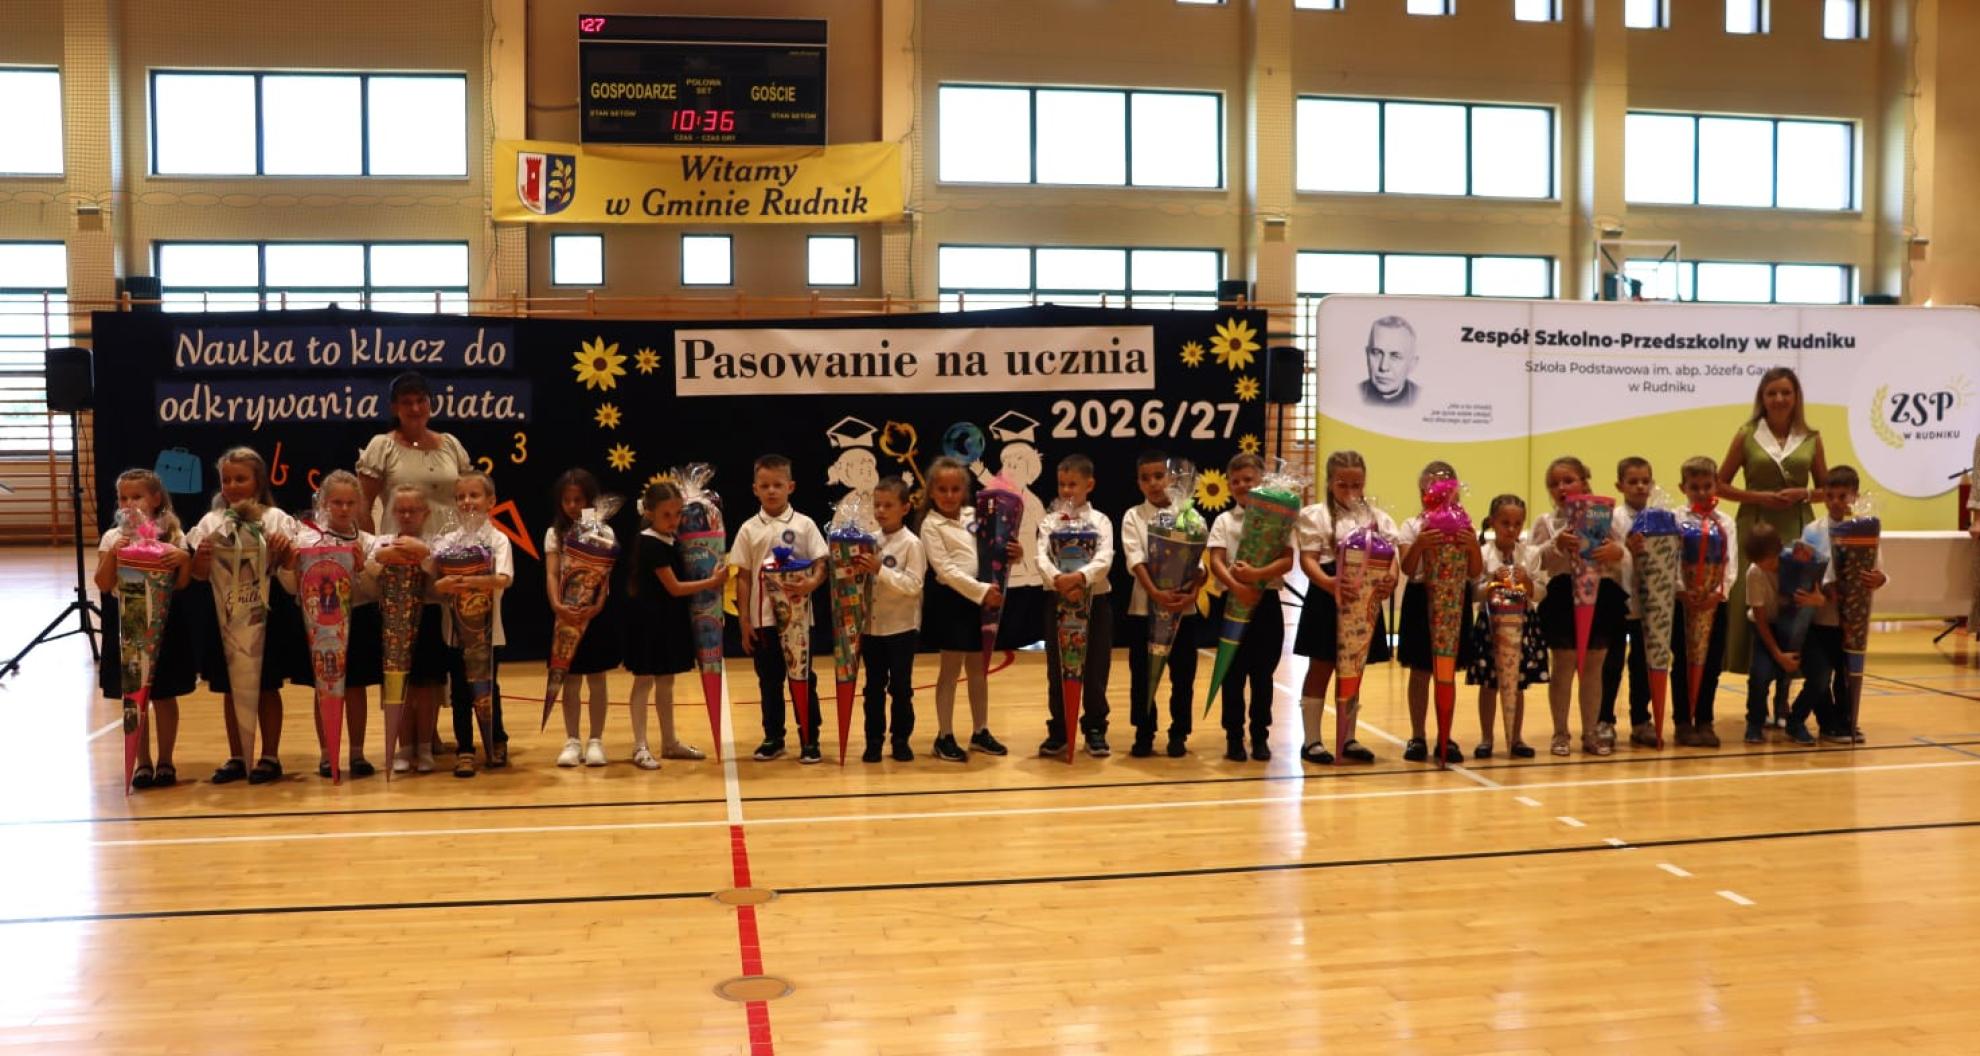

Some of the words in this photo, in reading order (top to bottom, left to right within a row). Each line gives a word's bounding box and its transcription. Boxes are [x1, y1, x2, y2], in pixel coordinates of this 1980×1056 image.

[591, 82, 677, 99] GOSPODARZE
[751, 82, 796, 102] GOŚCIE
[671, 110, 735, 132] 10:36
[681, 155, 798, 186] Witamy
[605, 198, 630, 216] w
[643, 188, 750, 217] Gminie
[760, 186, 868, 216] Rudnik
[175, 329, 296, 368] Nauka
[307, 336, 341, 366] to
[351, 328, 446, 365] klucz
[464, 328, 506, 366] do
[1461, 327, 1530, 348] Zespół
[1535, 329, 1750, 353] Szkolno-Przedszkolny
[1755, 336, 1772, 349] w
[1777, 332, 1856, 349] Rudniku
[681, 339, 918, 379] Pasowanie
[935, 351, 988, 377] na
[1004, 337, 1149, 376] ucznia
[1525, 361, 1566, 373] Szkoła
[1570, 362, 1650, 376] Podstawowa
[1653, 364, 1671, 376] im.
[1675, 364, 1702, 379] abp.
[1704, 364, 1743, 377] Józefa
[1628, 384, 1640, 392] w
[1644, 382, 1695, 393] Rudniku
[159, 383, 379, 431] odkrywania
[430, 384, 525, 419] iata.
[1051, 399, 1240, 439] 2026/27
[1890, 391, 1954, 427] ZSP
[511, 433, 527, 463] 3
[1915, 430, 1960, 440] RUDNIKU
